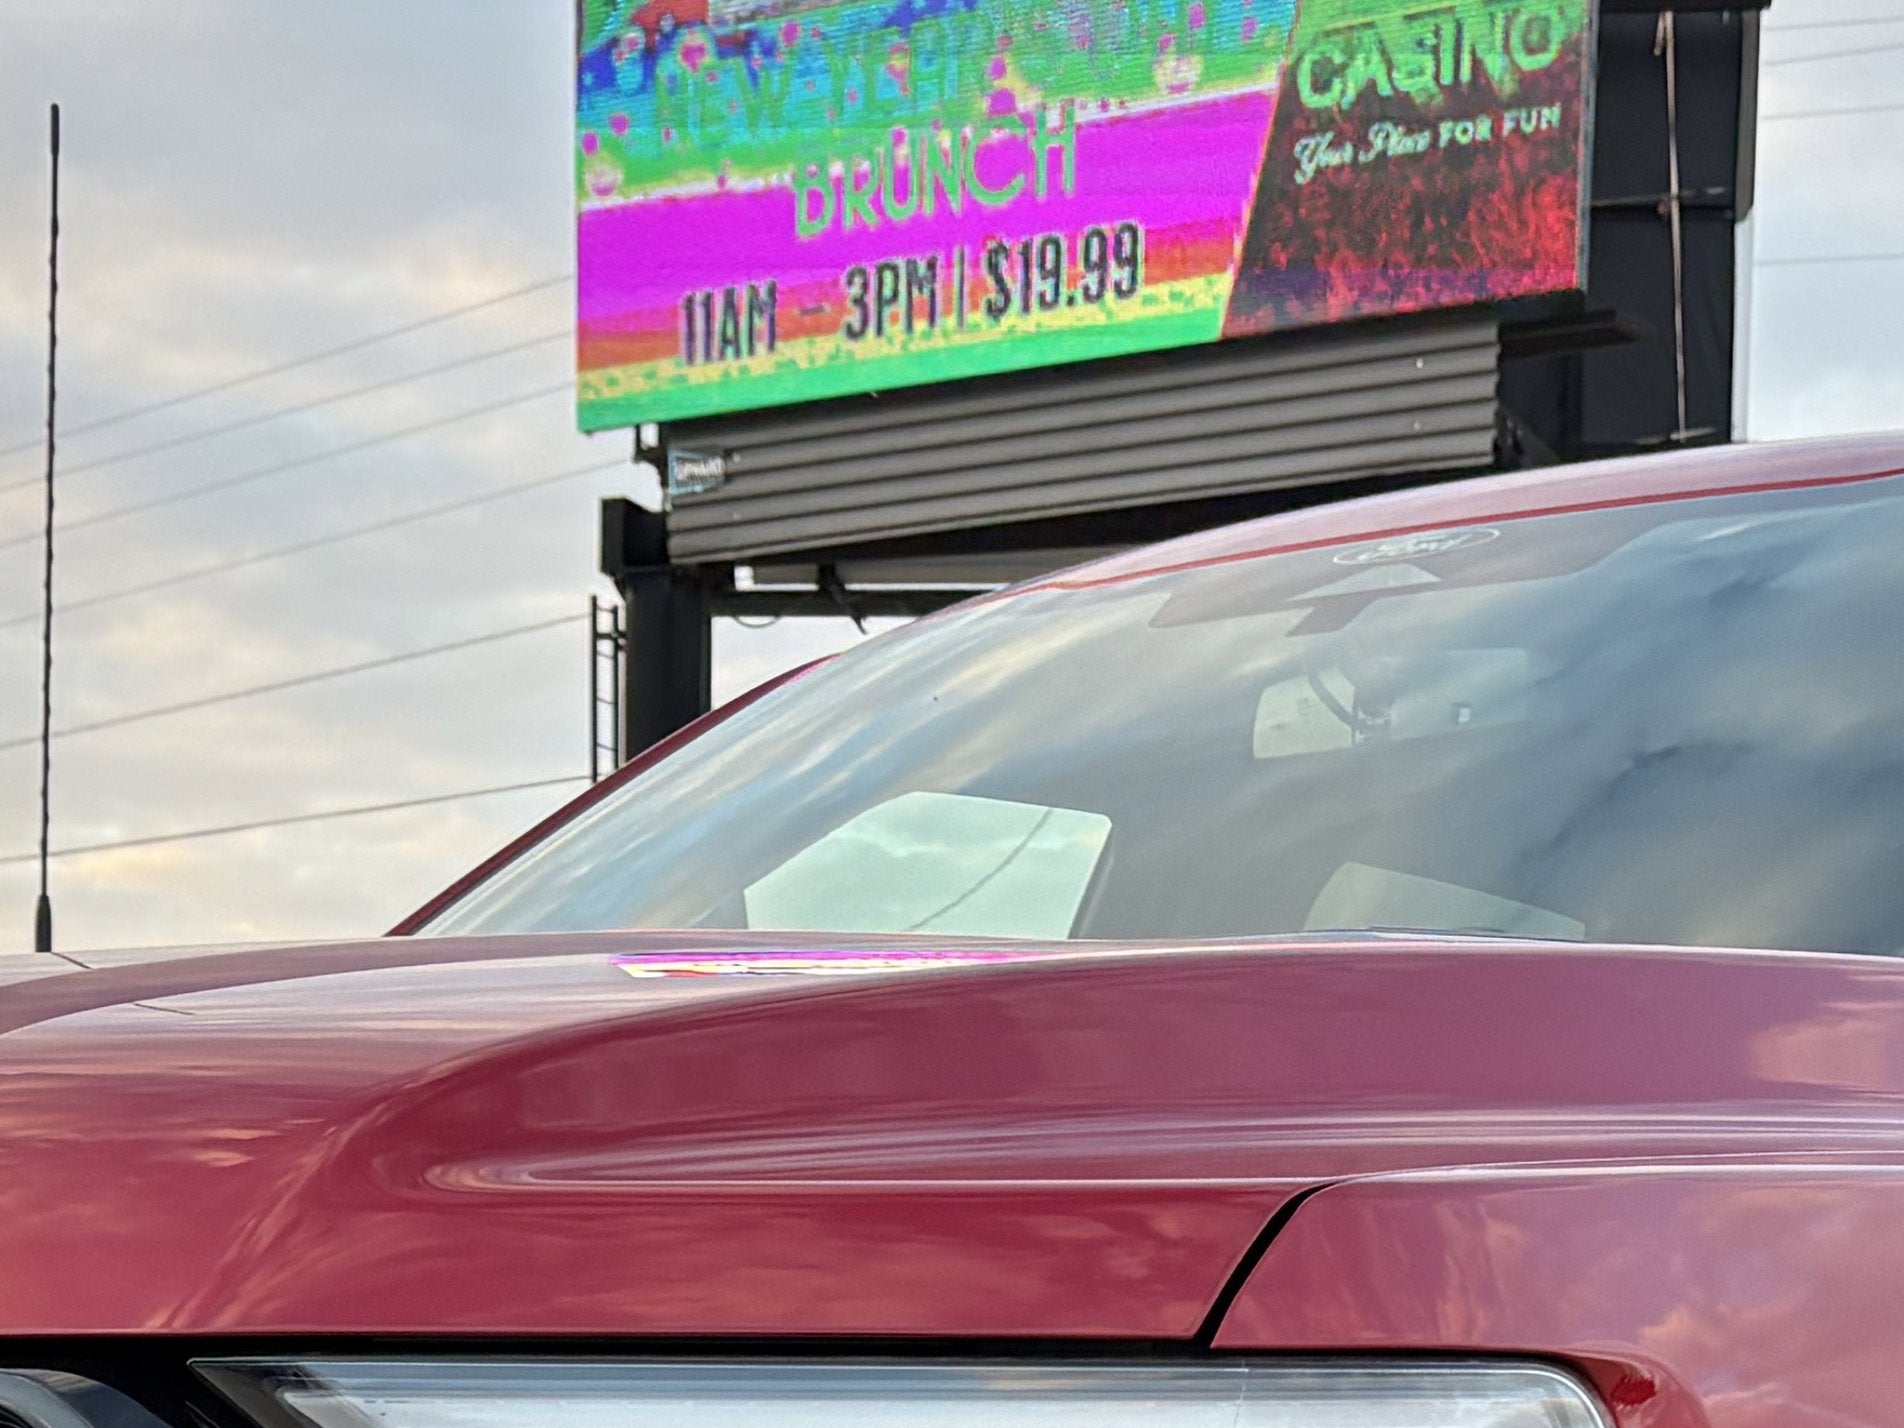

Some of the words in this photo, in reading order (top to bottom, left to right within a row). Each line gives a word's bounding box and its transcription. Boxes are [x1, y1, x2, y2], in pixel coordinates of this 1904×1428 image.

[1297, 4, 1565, 110] CASINO
[796, 99, 1077, 239] BRUNCH
[1439, 114, 1492, 148] FOR
[1502, 102, 1562, 137] FUN
[681, 278, 778, 365] 11AM
[843, 256, 939, 341] 3PM
[983, 220, 1143, 322] $19.99
